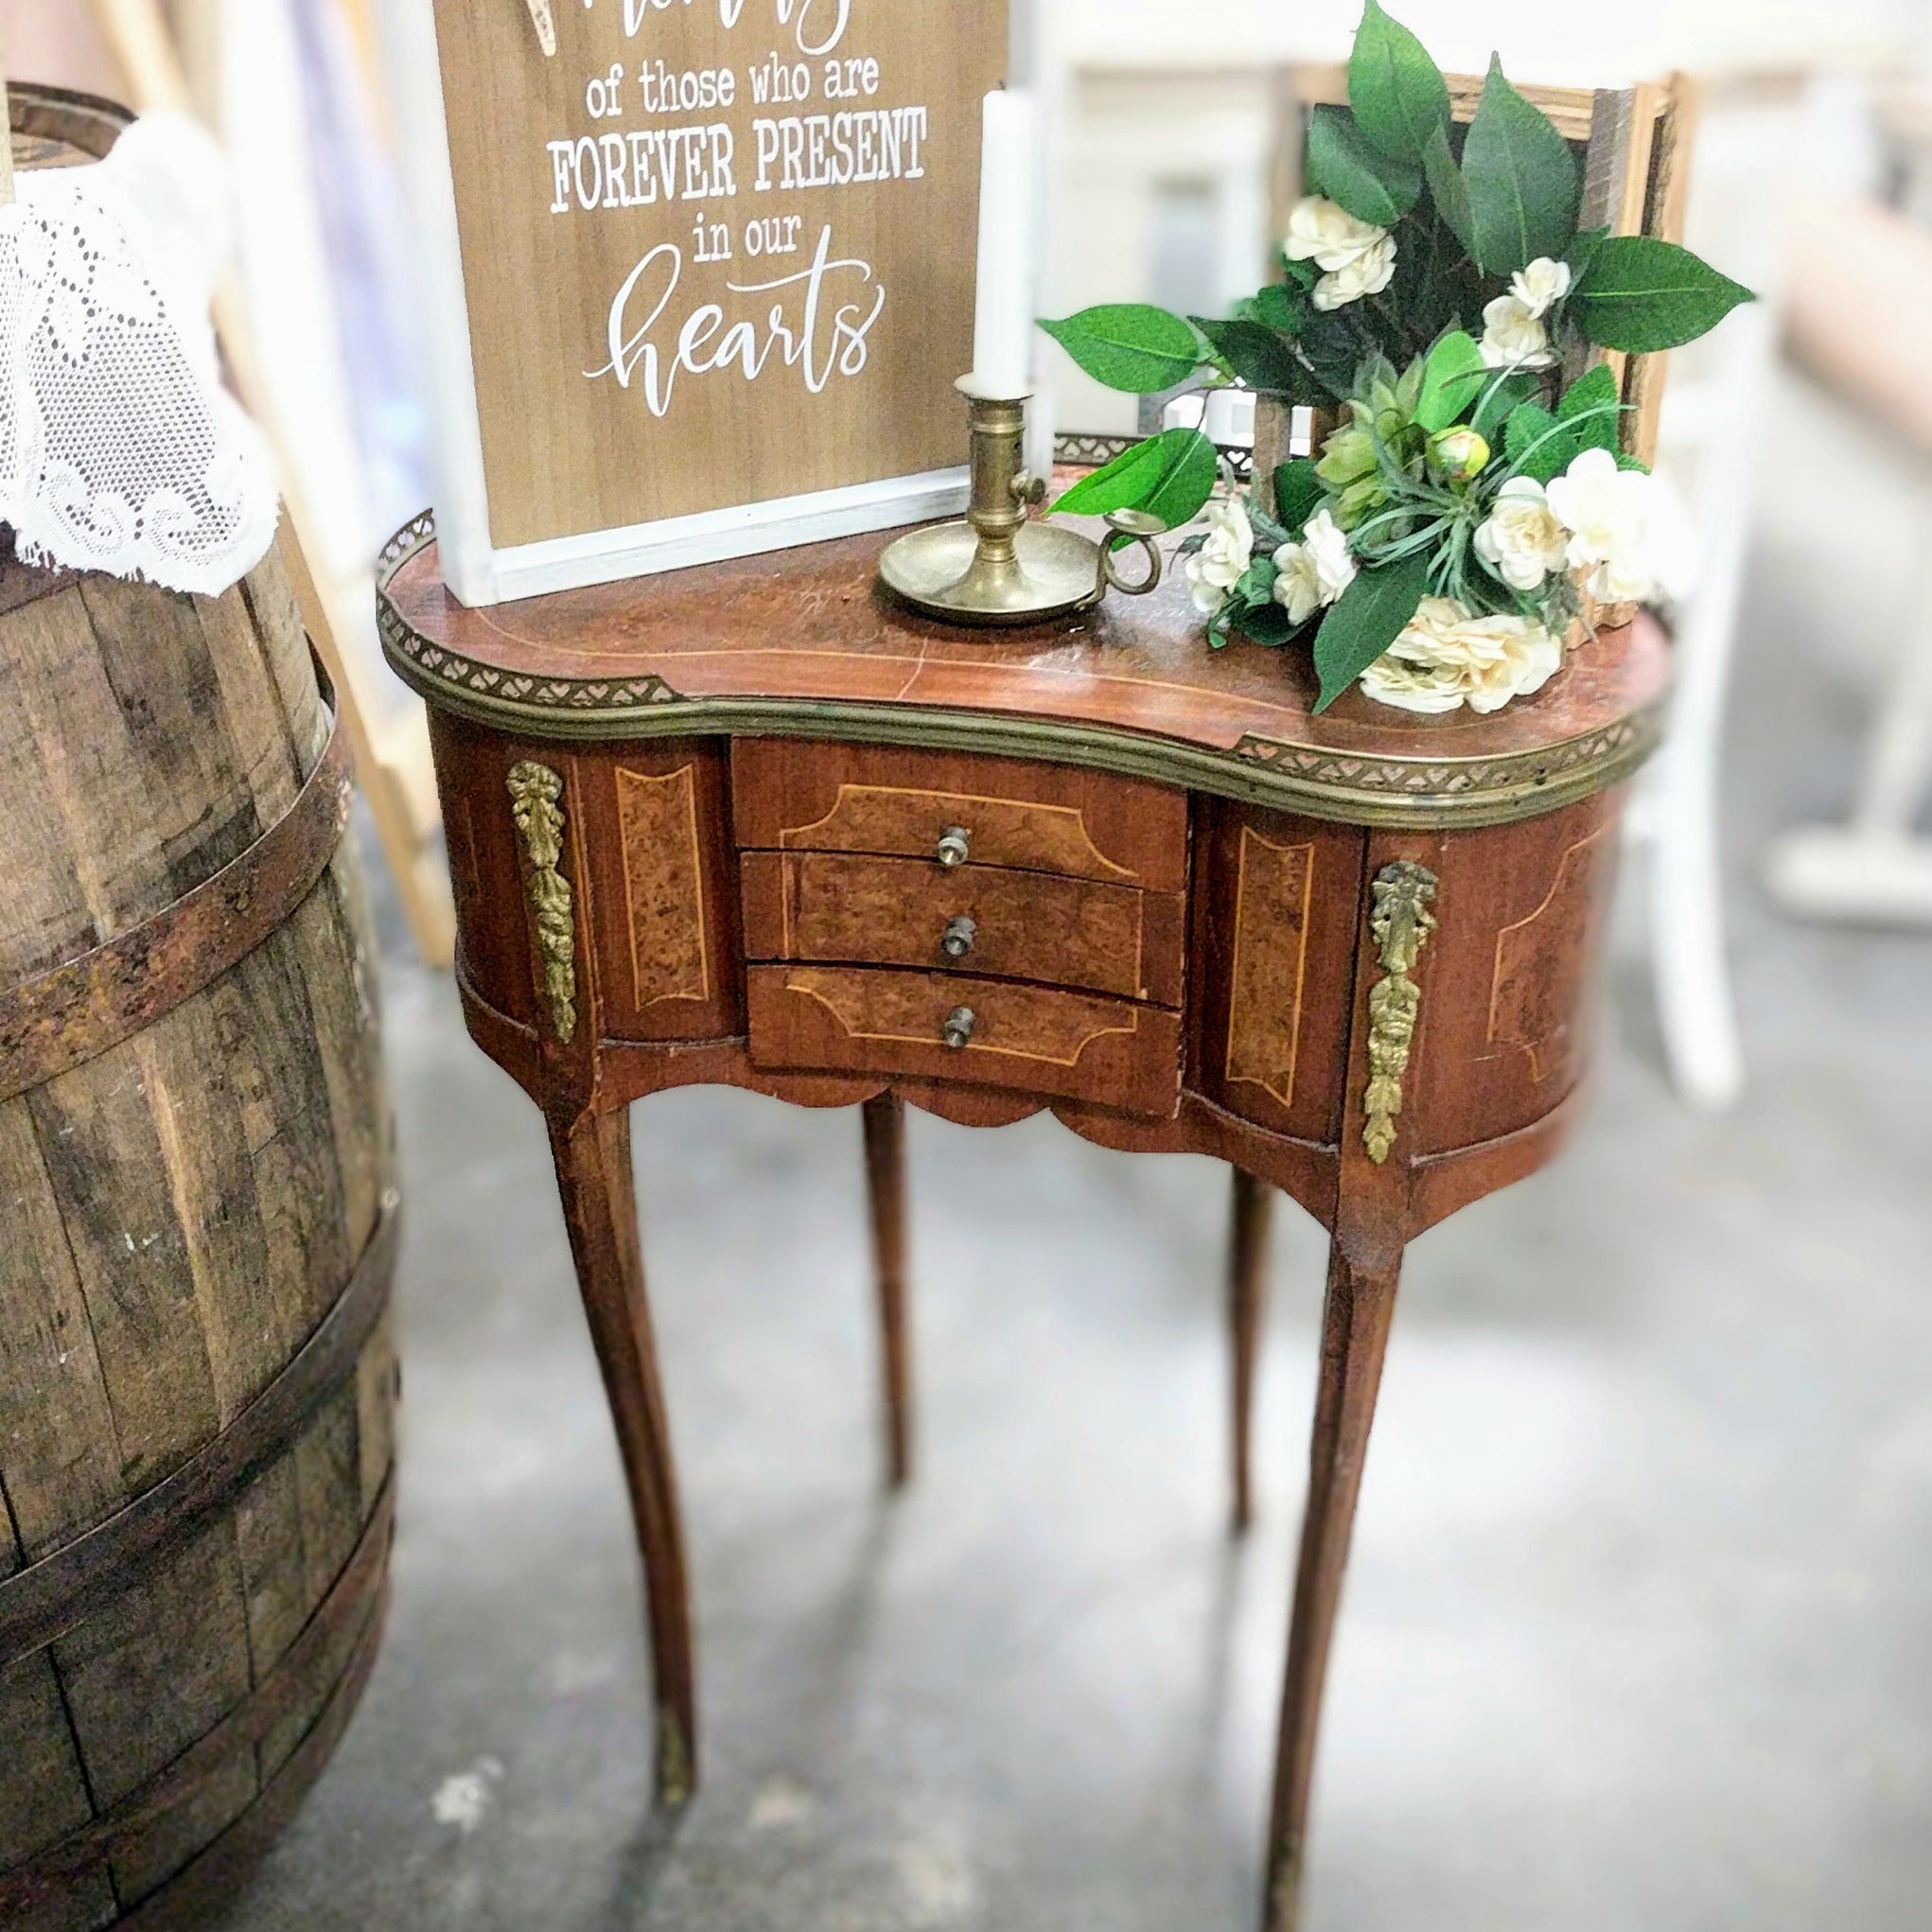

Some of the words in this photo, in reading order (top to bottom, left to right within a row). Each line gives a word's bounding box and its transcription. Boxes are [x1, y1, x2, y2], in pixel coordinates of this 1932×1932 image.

[586, 62, 624, 118] of
[638, 60, 736, 114] those
[748, 51, 811, 105] who
[823, 56, 880, 99] are
[546, 123, 737, 215] FOREVER
[750, 105, 929, 192] PRESENT
[693, 212, 732, 264] in
[745, 214, 802, 257] our
[581, 224, 886, 417] hearts
